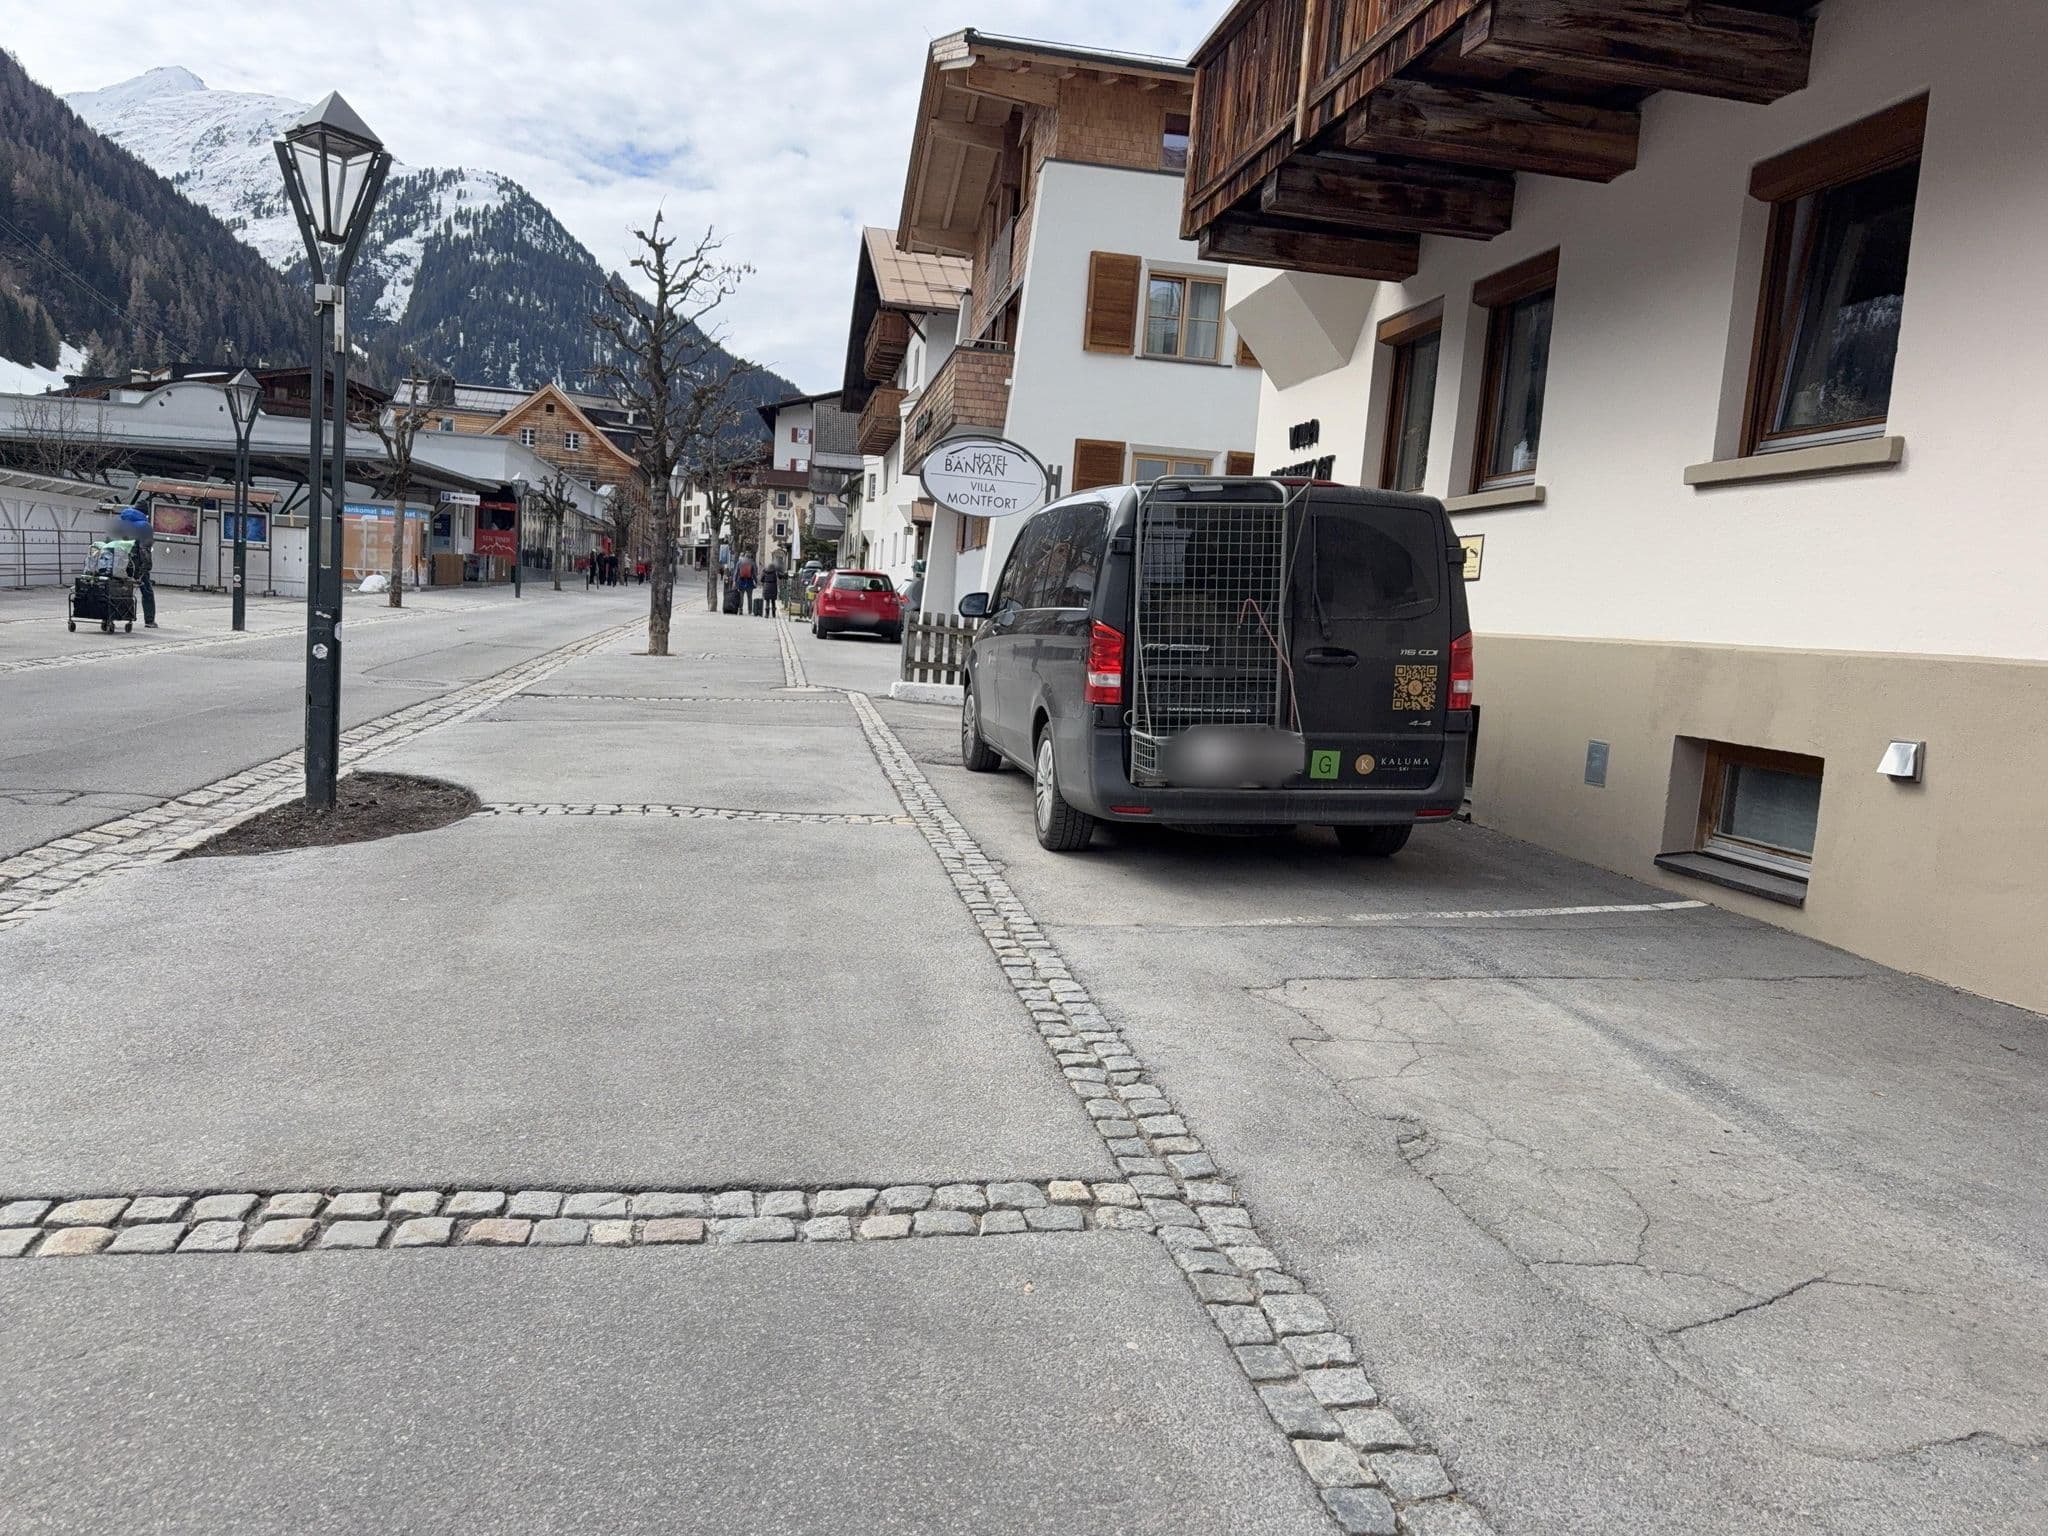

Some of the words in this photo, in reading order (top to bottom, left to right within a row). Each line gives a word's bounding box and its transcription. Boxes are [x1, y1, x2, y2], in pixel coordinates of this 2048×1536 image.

[973, 452, 1008, 466] HOTEL
[945, 458, 1006, 477] BANYAN
[970, 481, 996, 493] VILLA
[946, 492, 1018, 509] MONTFORT
[1318, 755, 1332, 774] G
[1361, 759, 1370, 770] K
